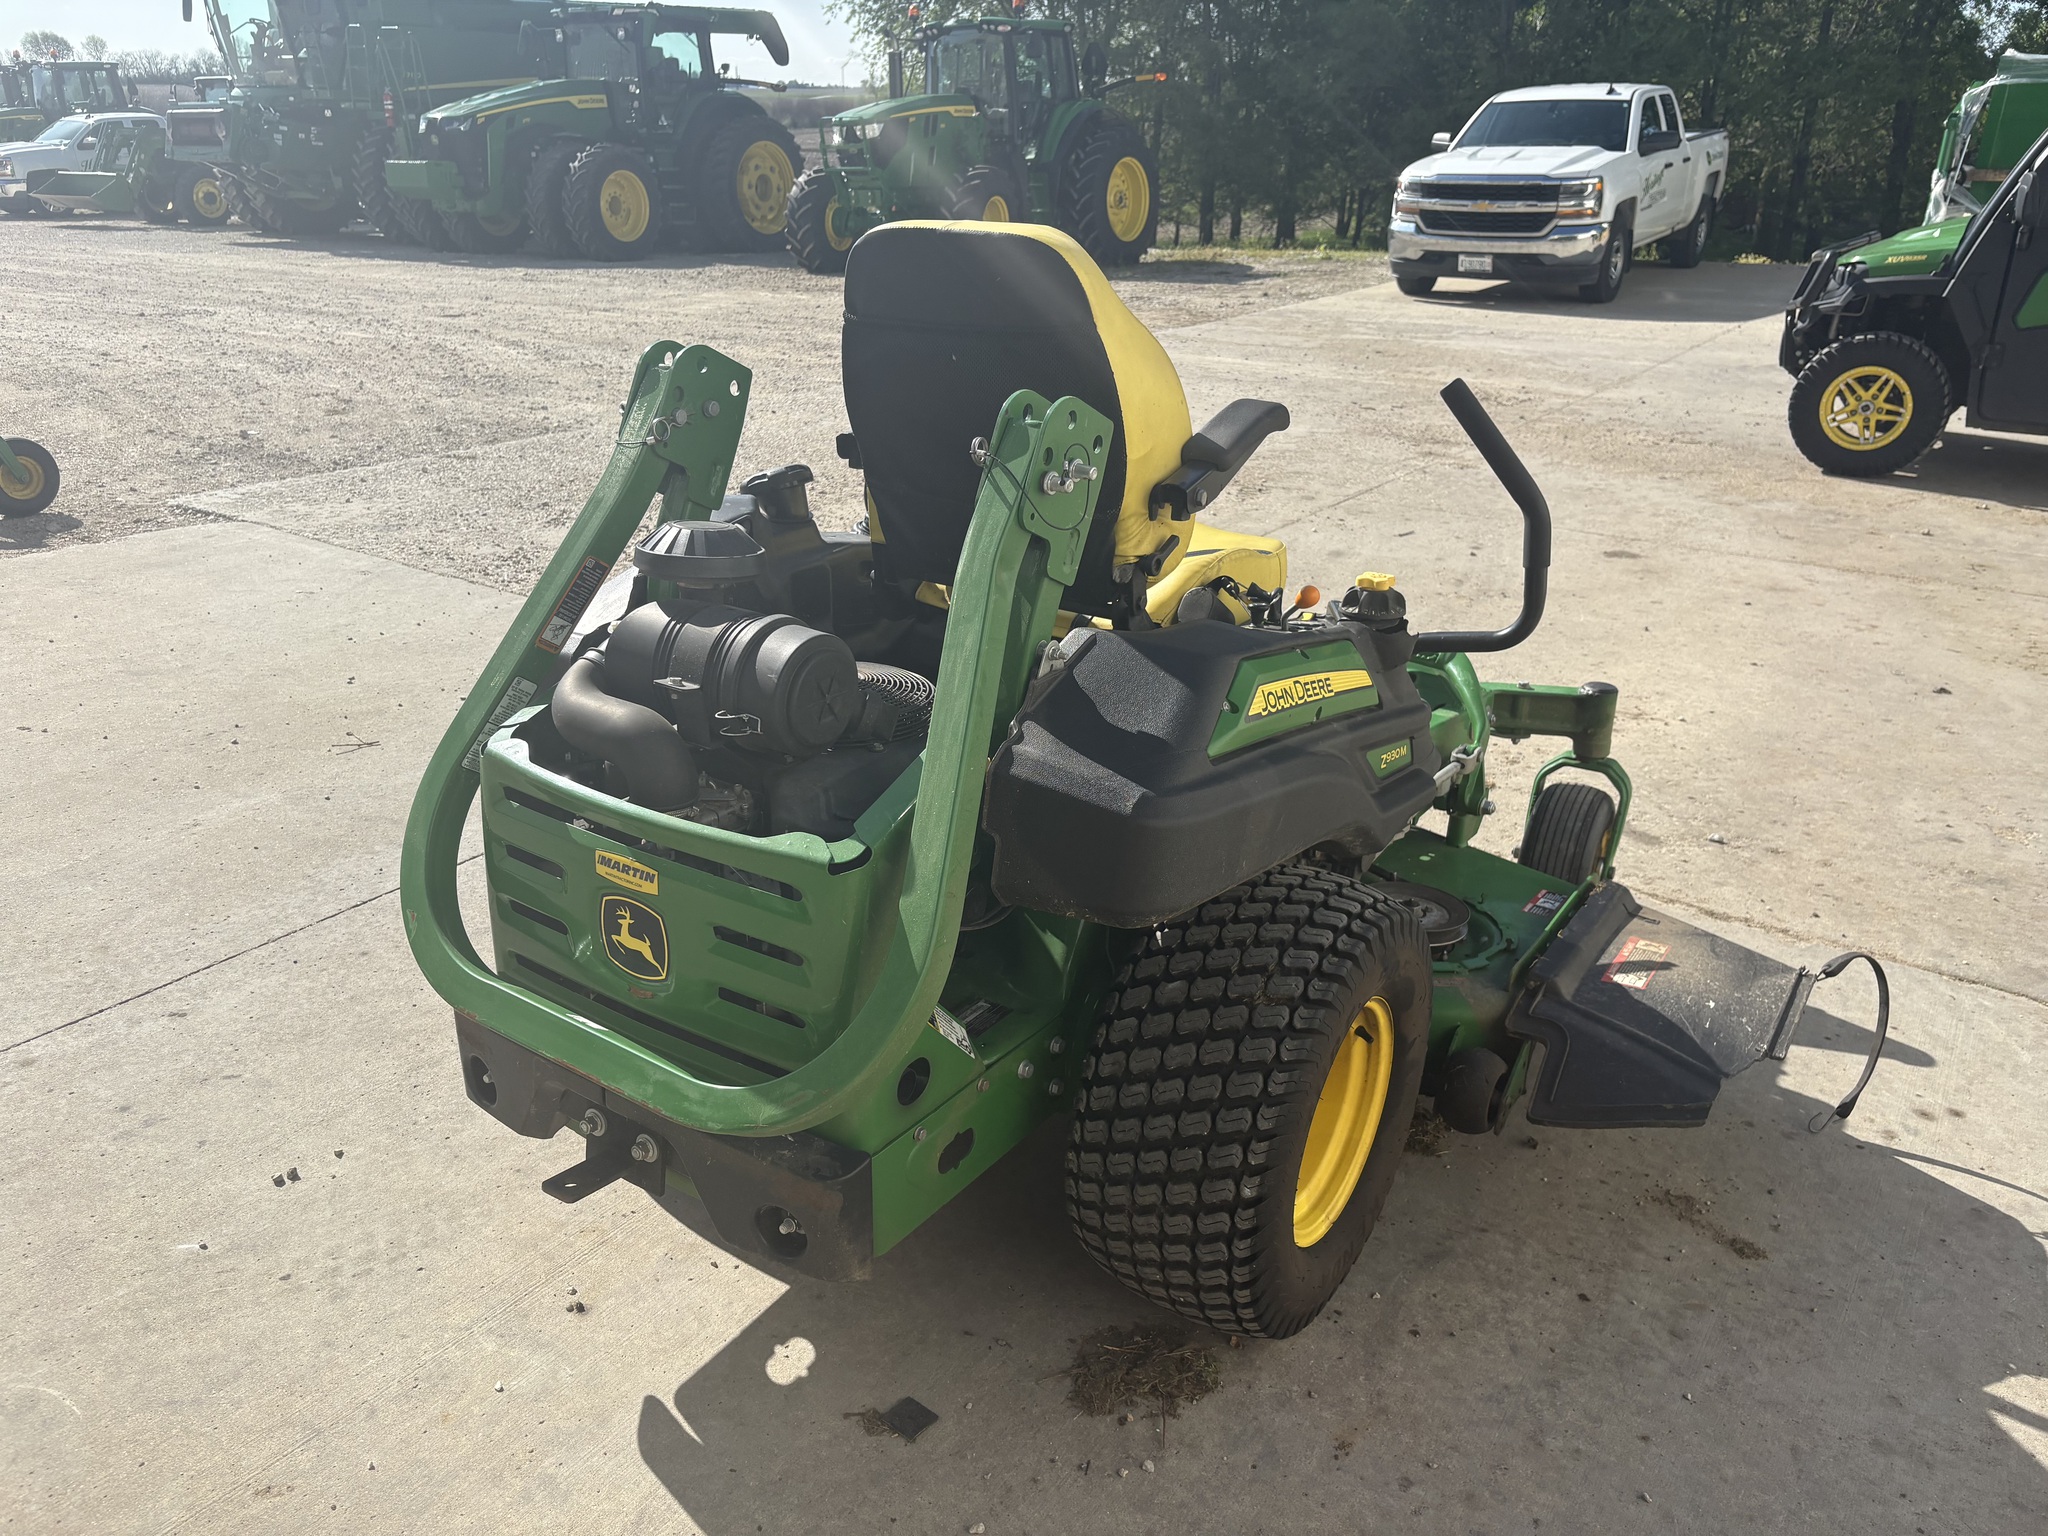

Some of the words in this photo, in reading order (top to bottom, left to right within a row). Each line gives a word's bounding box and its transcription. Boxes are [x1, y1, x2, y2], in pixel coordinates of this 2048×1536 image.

[1261, 685, 1296, 712] JOHN
[1293, 677, 1334, 701] DEERE
[1380, 744, 1407, 769] Z930M
[597, 854, 657, 884] MARTIN
